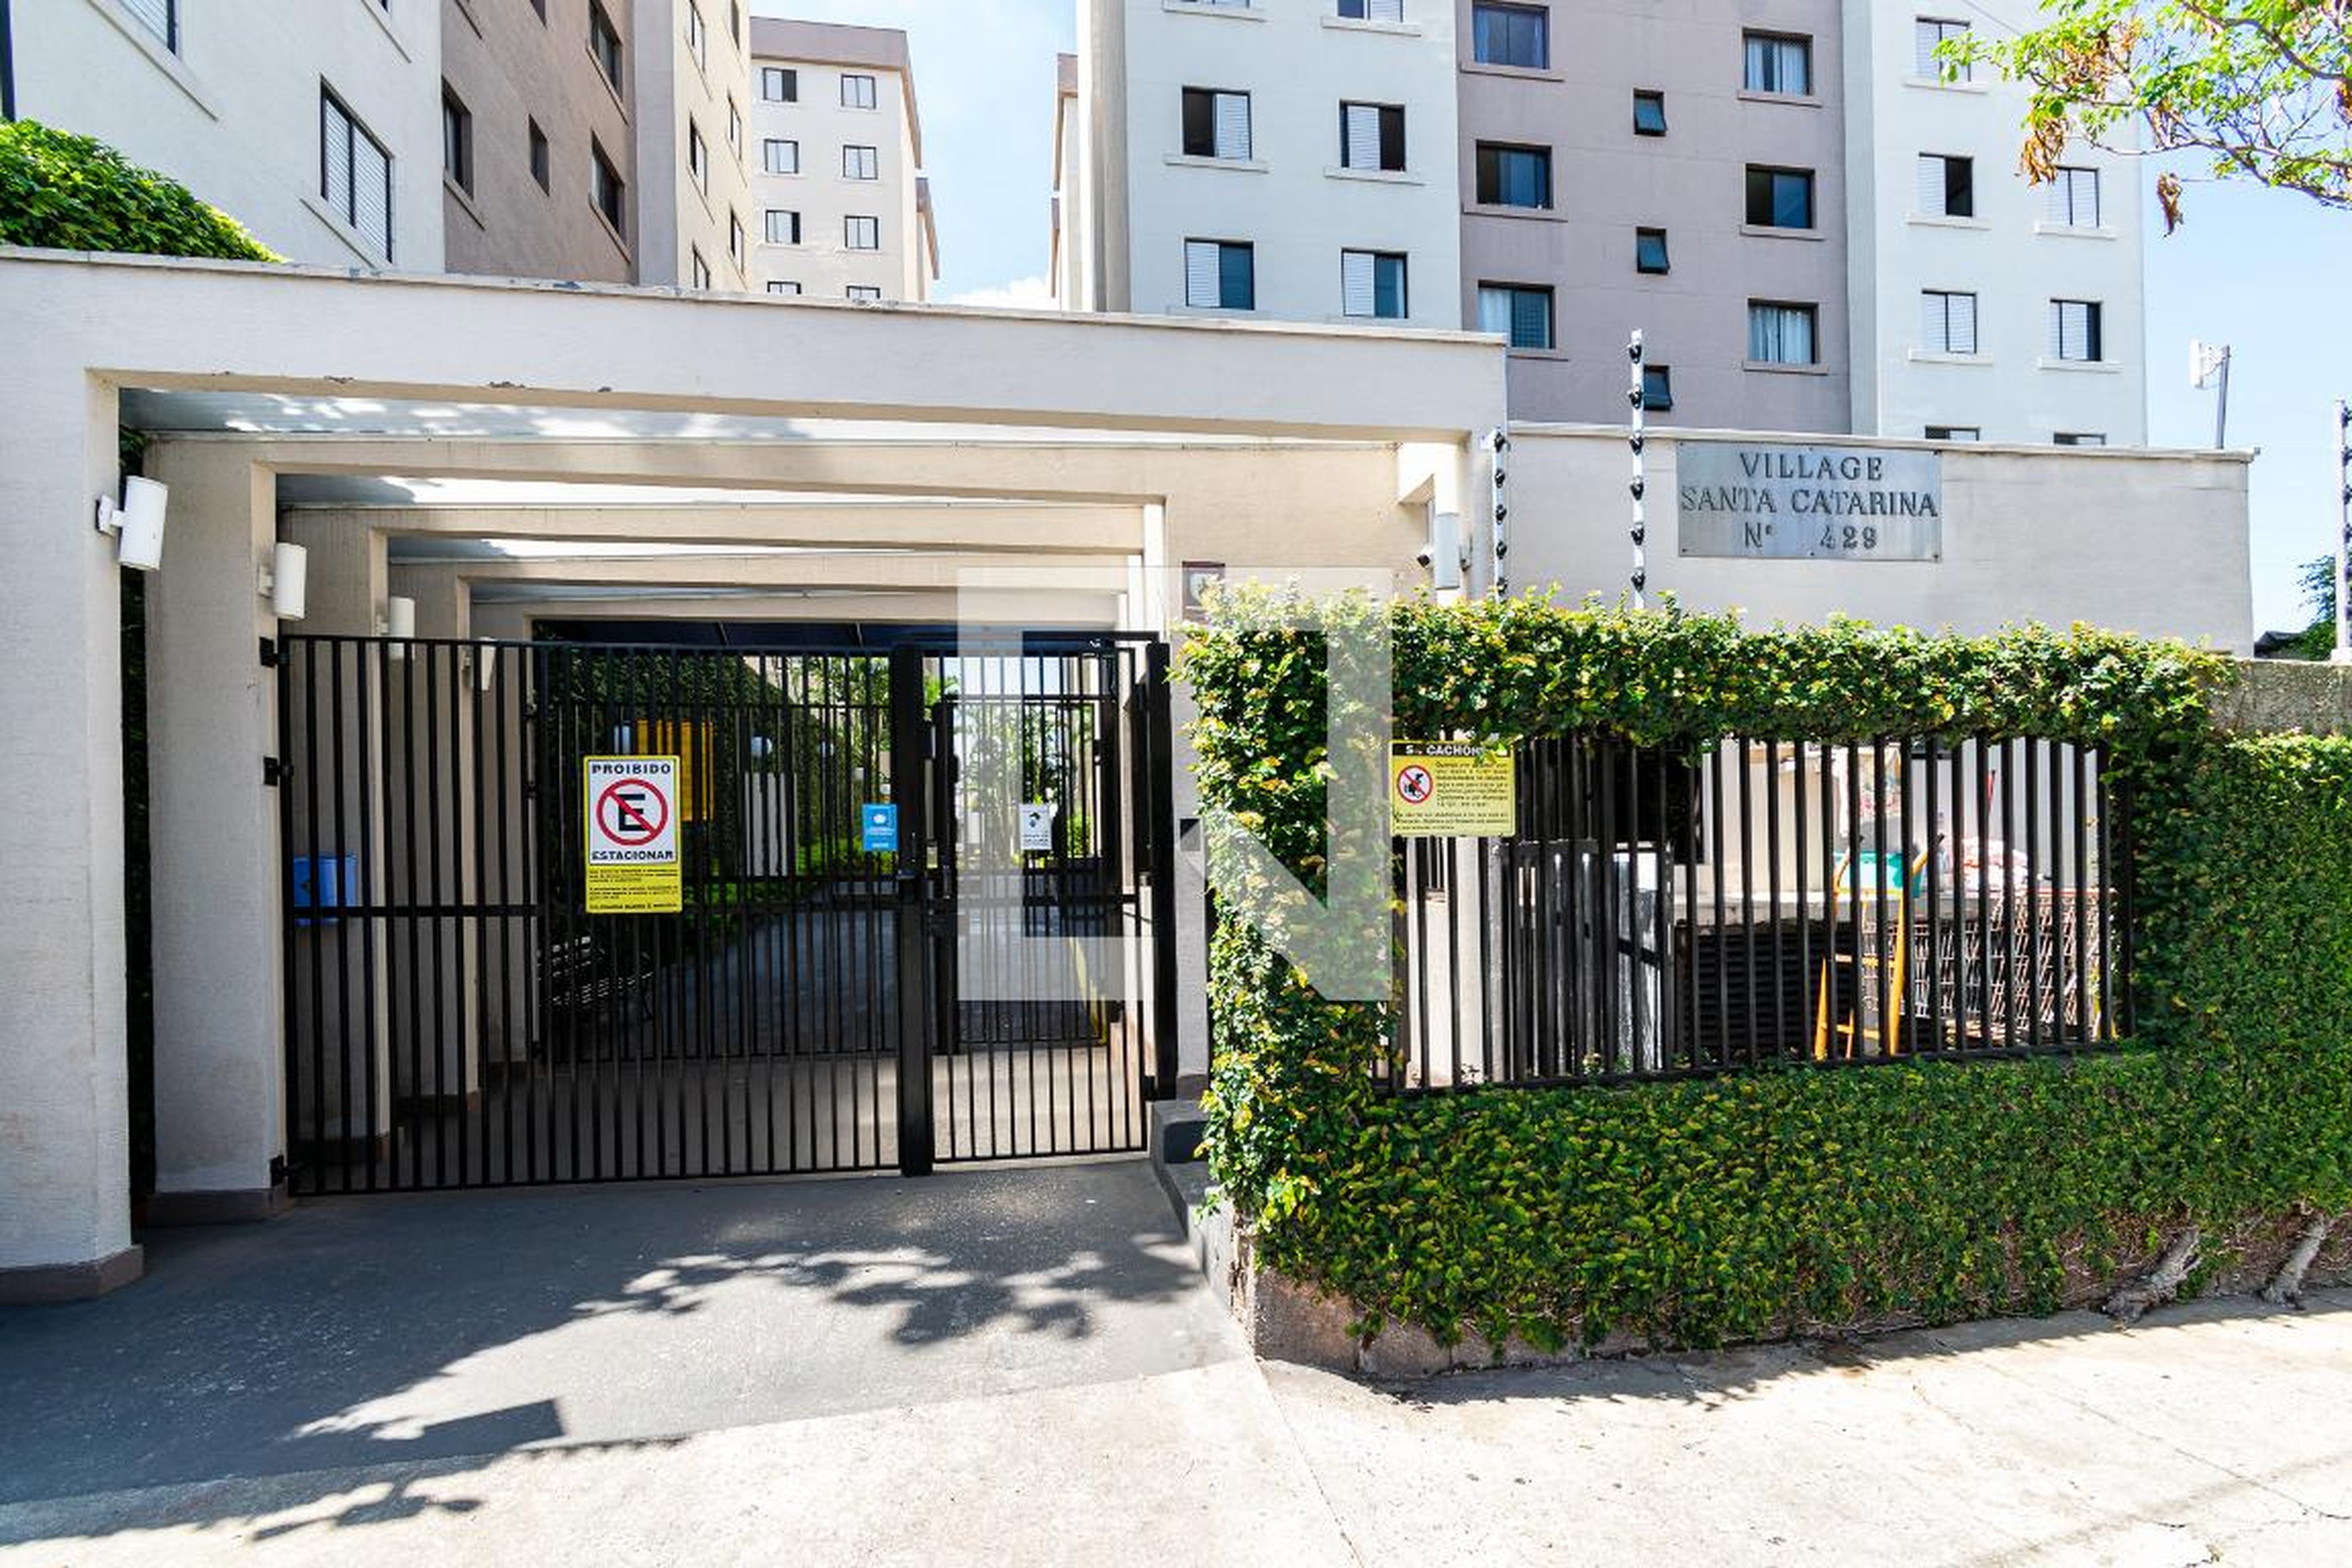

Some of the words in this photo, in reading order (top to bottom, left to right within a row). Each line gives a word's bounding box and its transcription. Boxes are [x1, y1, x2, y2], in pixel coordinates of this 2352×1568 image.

[1740, 453, 1882, 480] VILLAGE
[1681, 485, 1776, 513] SANTA
[1791, 490, 1937, 518] CATARINA
[592, 764, 671, 774] PROIBIDO
[592, 851, 673, 860] ESTACIONAR
